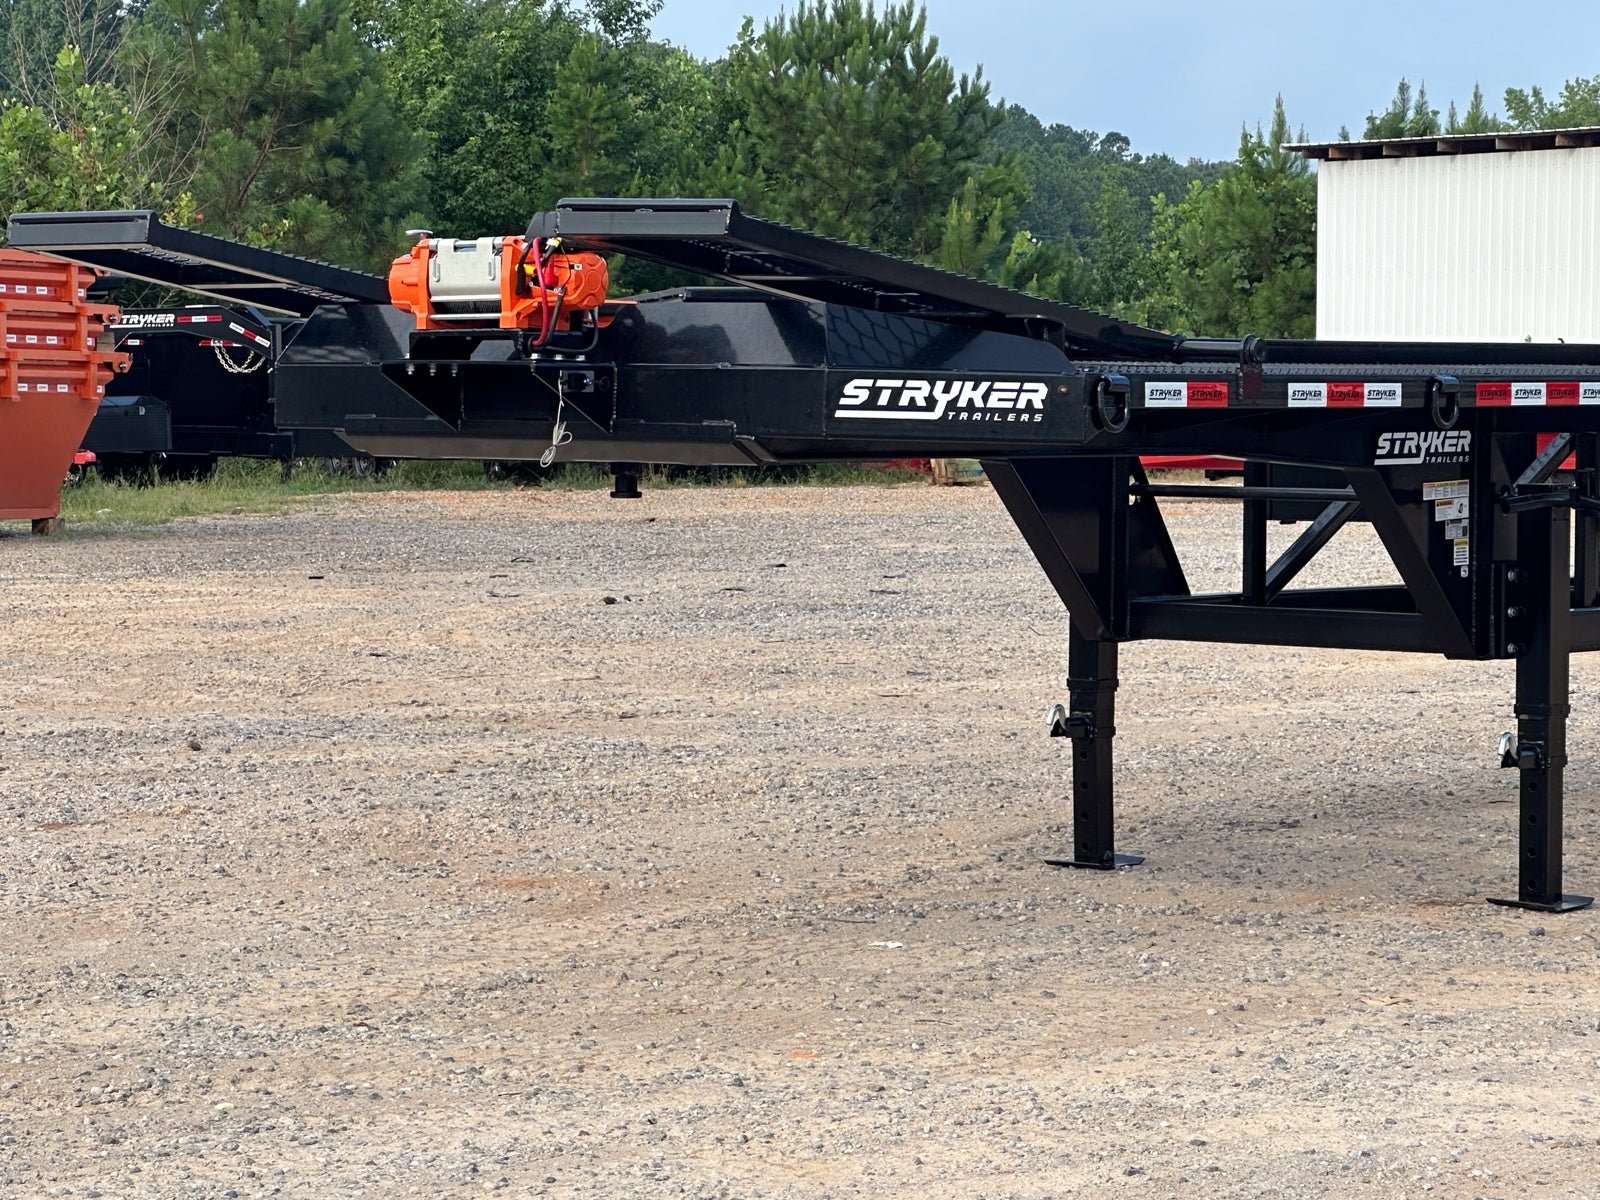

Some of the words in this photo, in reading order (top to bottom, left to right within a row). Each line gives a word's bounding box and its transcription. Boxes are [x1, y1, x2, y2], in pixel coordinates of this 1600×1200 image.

[113, 314, 175, 328] TRYKER
[1149, 389, 1182, 400] STRYKER
[1292, 390, 1322, 400] STRYKER
[1367, 390, 1397, 400] STRYKER
[1515, 389, 1542, 399] STRYKER
[835, 379, 1048, 420] STRYKER
[947, 412, 1043, 422] TRAILERS
[1374, 430, 1472, 465] STRYKER
[1426, 455, 1470, 464] TRAILERS
